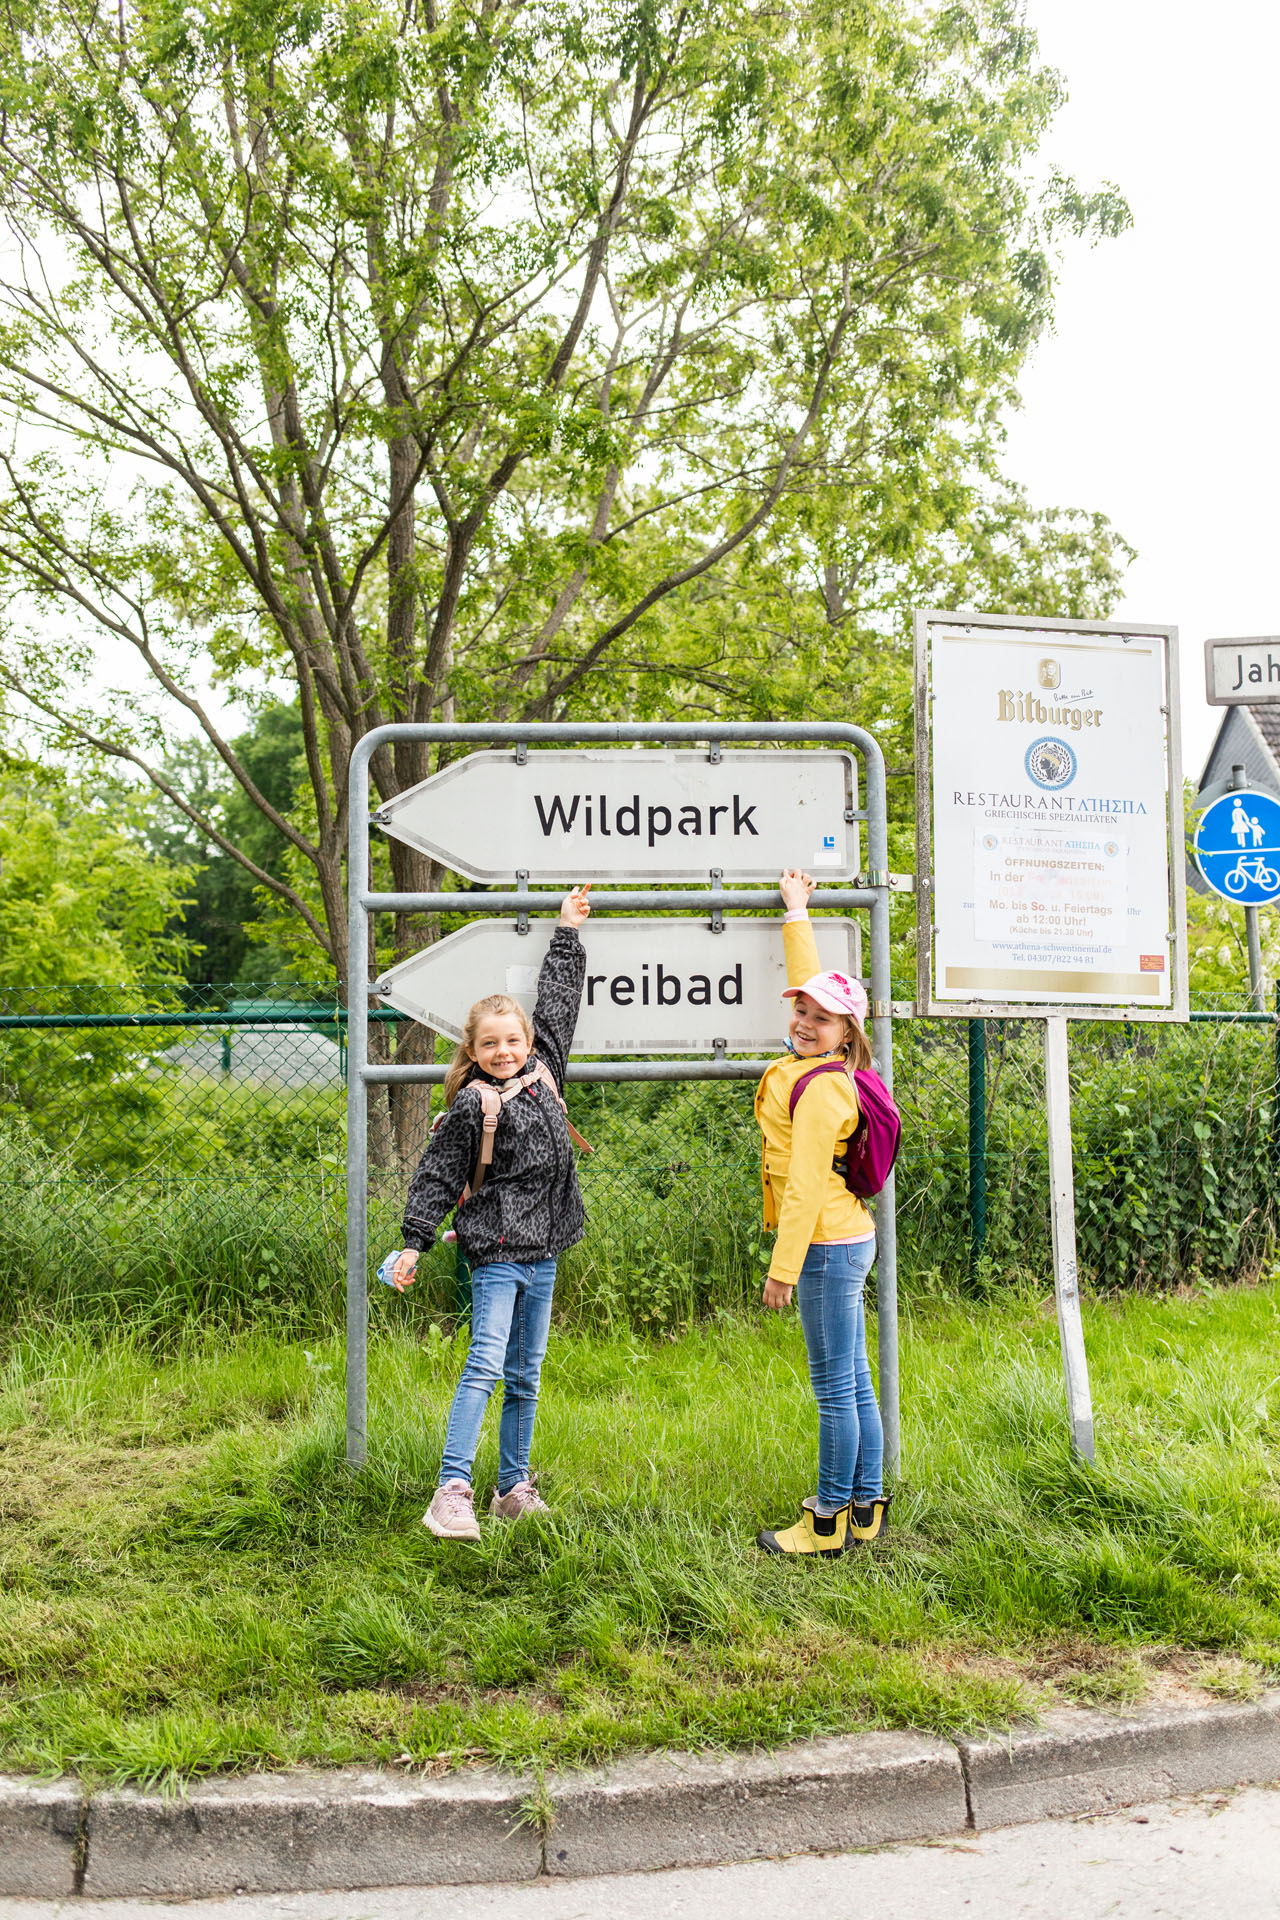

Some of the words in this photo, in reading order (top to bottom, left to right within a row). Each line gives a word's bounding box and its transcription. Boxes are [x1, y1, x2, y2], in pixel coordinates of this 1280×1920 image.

[1232, 654, 1280, 691] Jah
[996, 689, 1103, 731] Bitburger
[534, 795, 759, 847] Wildpark
[984, 809, 1047, 821] GRIECHISCHE
[1049, 812, 1118, 824] SPEZIALITÄTEN
[1004, 856, 1105, 872] ÖFFNUNGSZEITEN:
[990, 871, 1001, 881] In
[1004, 871, 1024, 882] der
[989, 899, 1008, 911] Mo.
[1012, 900, 1028, 911] bis
[1031, 901, 1048, 912] So.
[1051, 904, 1061, 912] u.
[1064, 903, 1113, 917] Feiertags
[1016, 914, 1030, 924] ab
[1033, 915, 1061, 925] 12:00
[1064, 916, 1086, 926] Uhr!
[1040, 927, 1051, 935] bis
[1076, 929, 1093, 938] Uhr)
[992, 942, 1112, 953] www.athena-schwentinental.de
[1012, 954, 1026, 962] Tel.
[1027, 955, 1070, 964] 04307/822
[1073, 956, 1084, 964] 94
[1085, 956, 1094, 964] 81
[587, 963, 743, 1006] reibad
